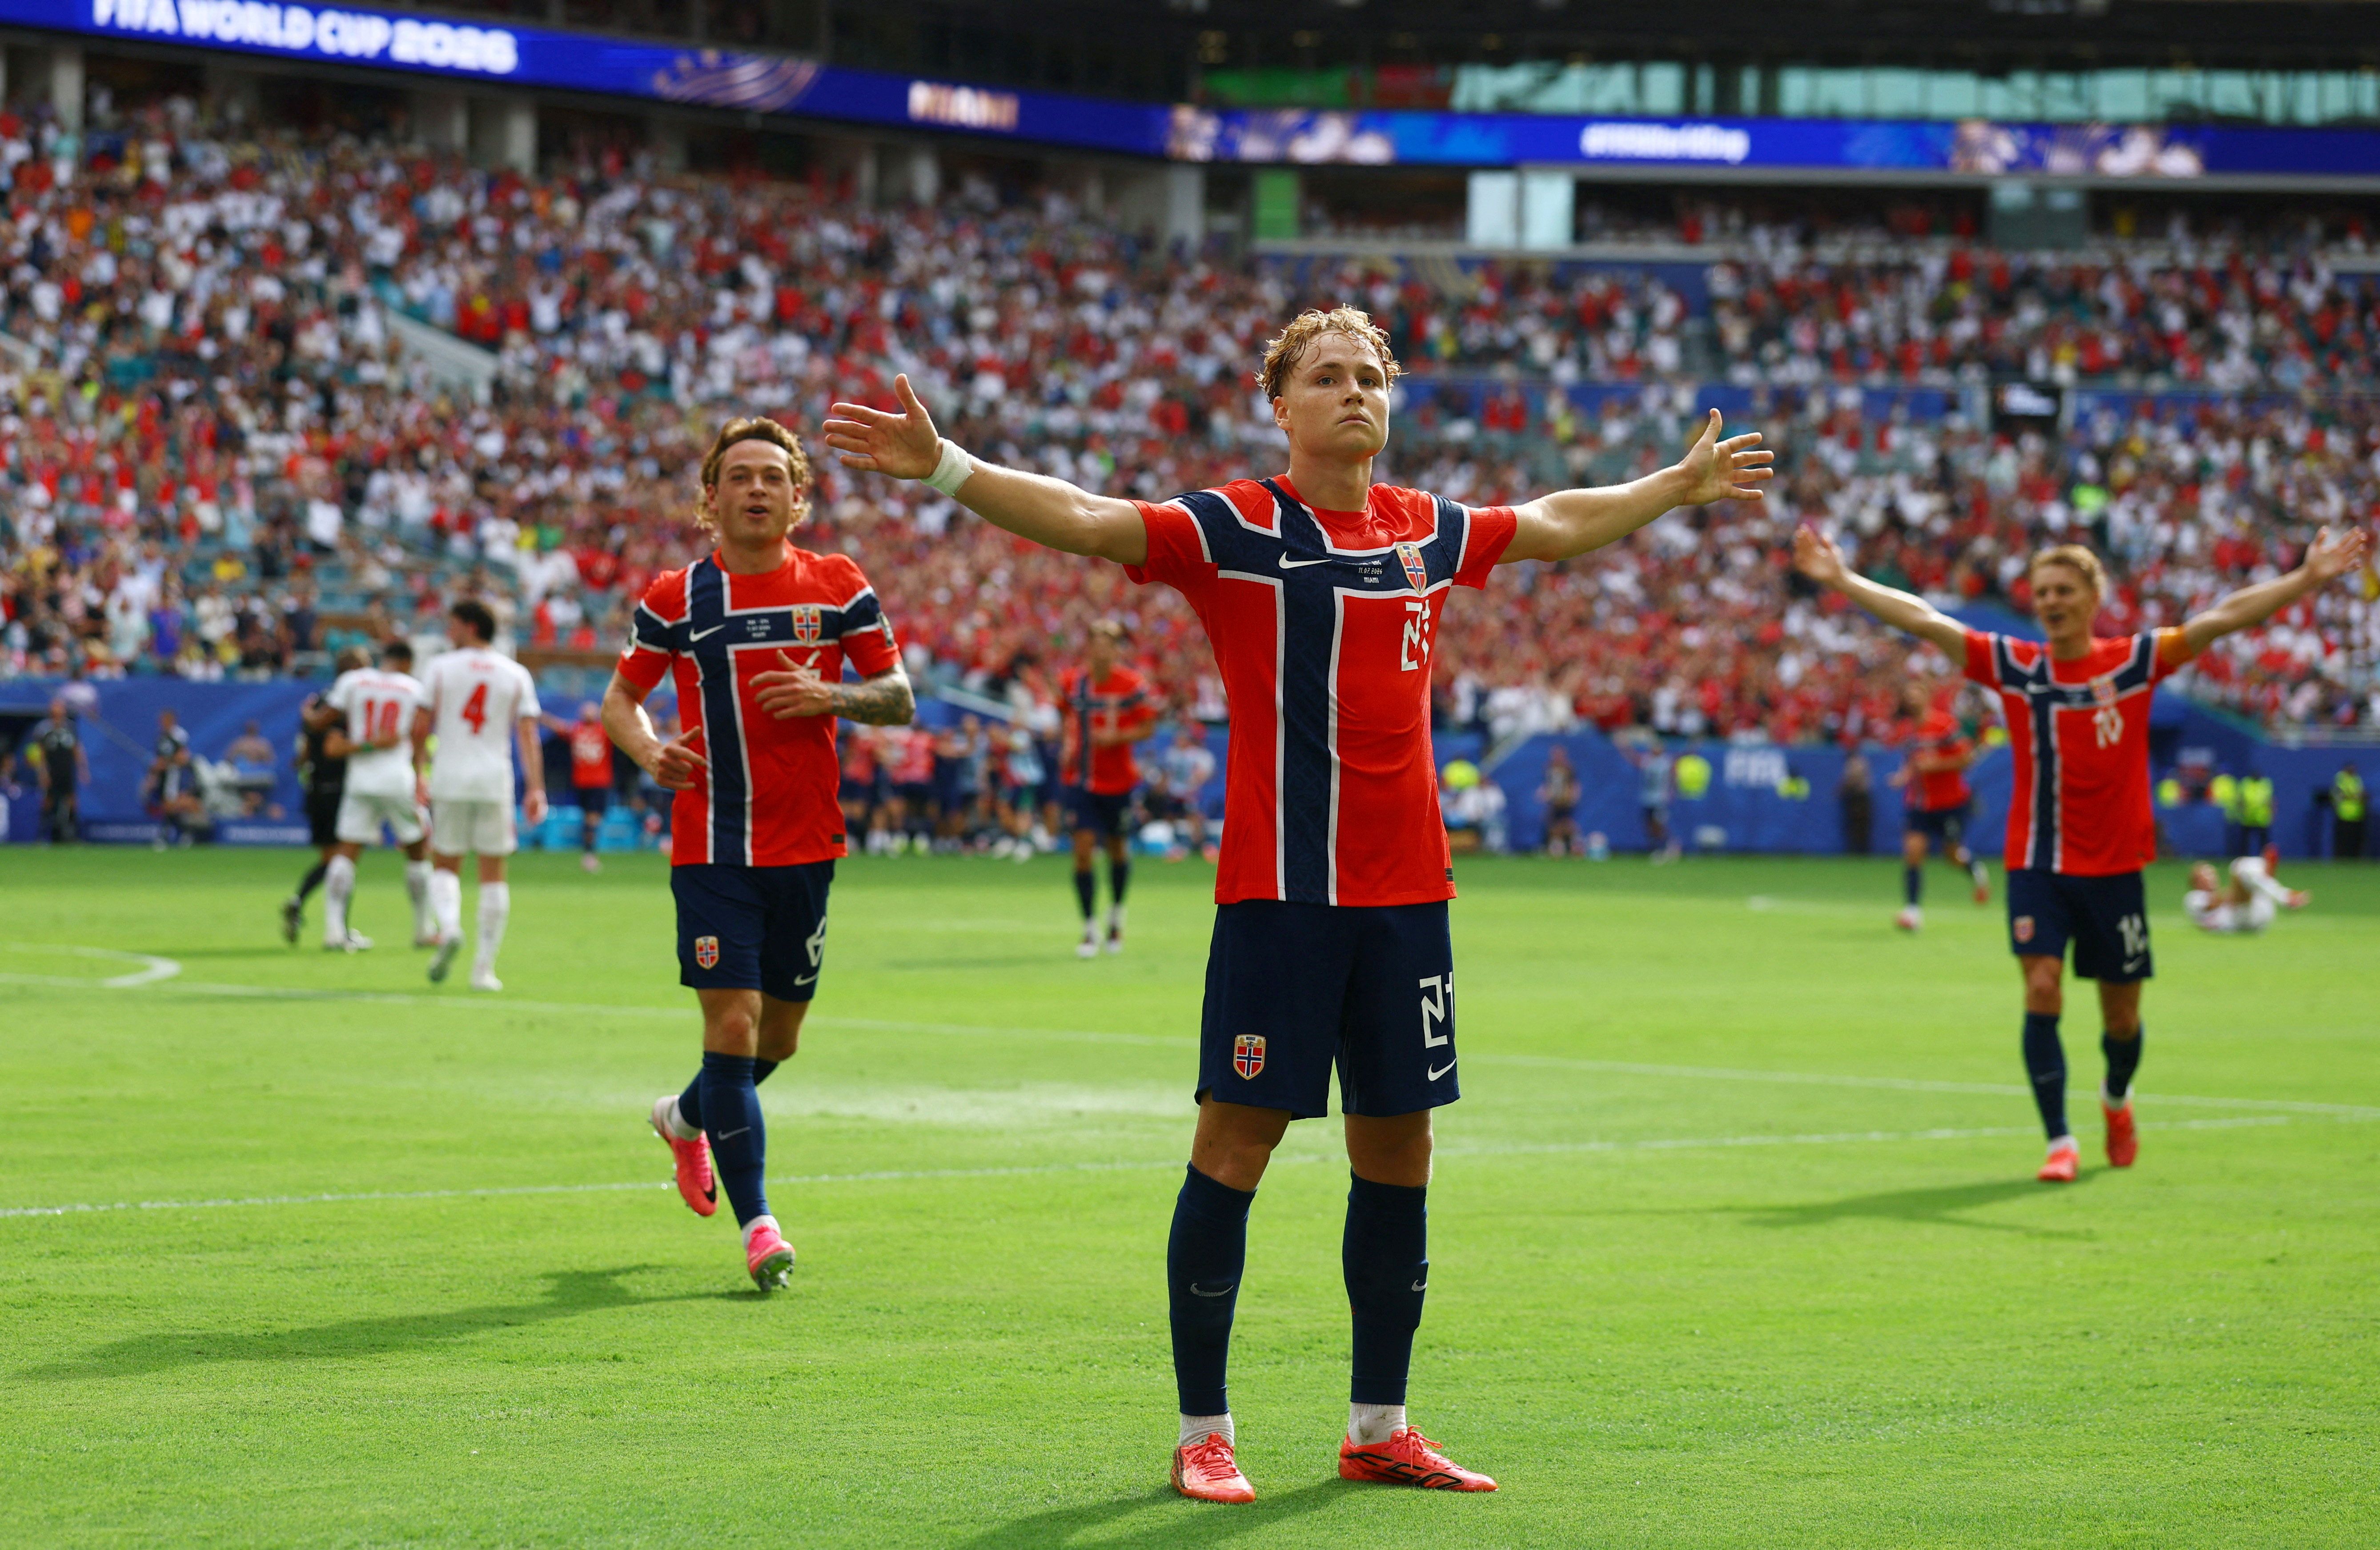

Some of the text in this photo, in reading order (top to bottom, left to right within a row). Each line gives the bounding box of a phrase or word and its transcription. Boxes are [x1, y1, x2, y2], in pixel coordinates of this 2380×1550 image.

[180, 0, 312, 48] WORLD
[316, 10, 390, 57] CUP
[390, 20, 517, 73] 2026
[1401, 599, 1431, 671] 21
[363, 698, 401, 742] 10
[461, 681, 486, 736] 4
[2092, 707, 2124, 749] 10
